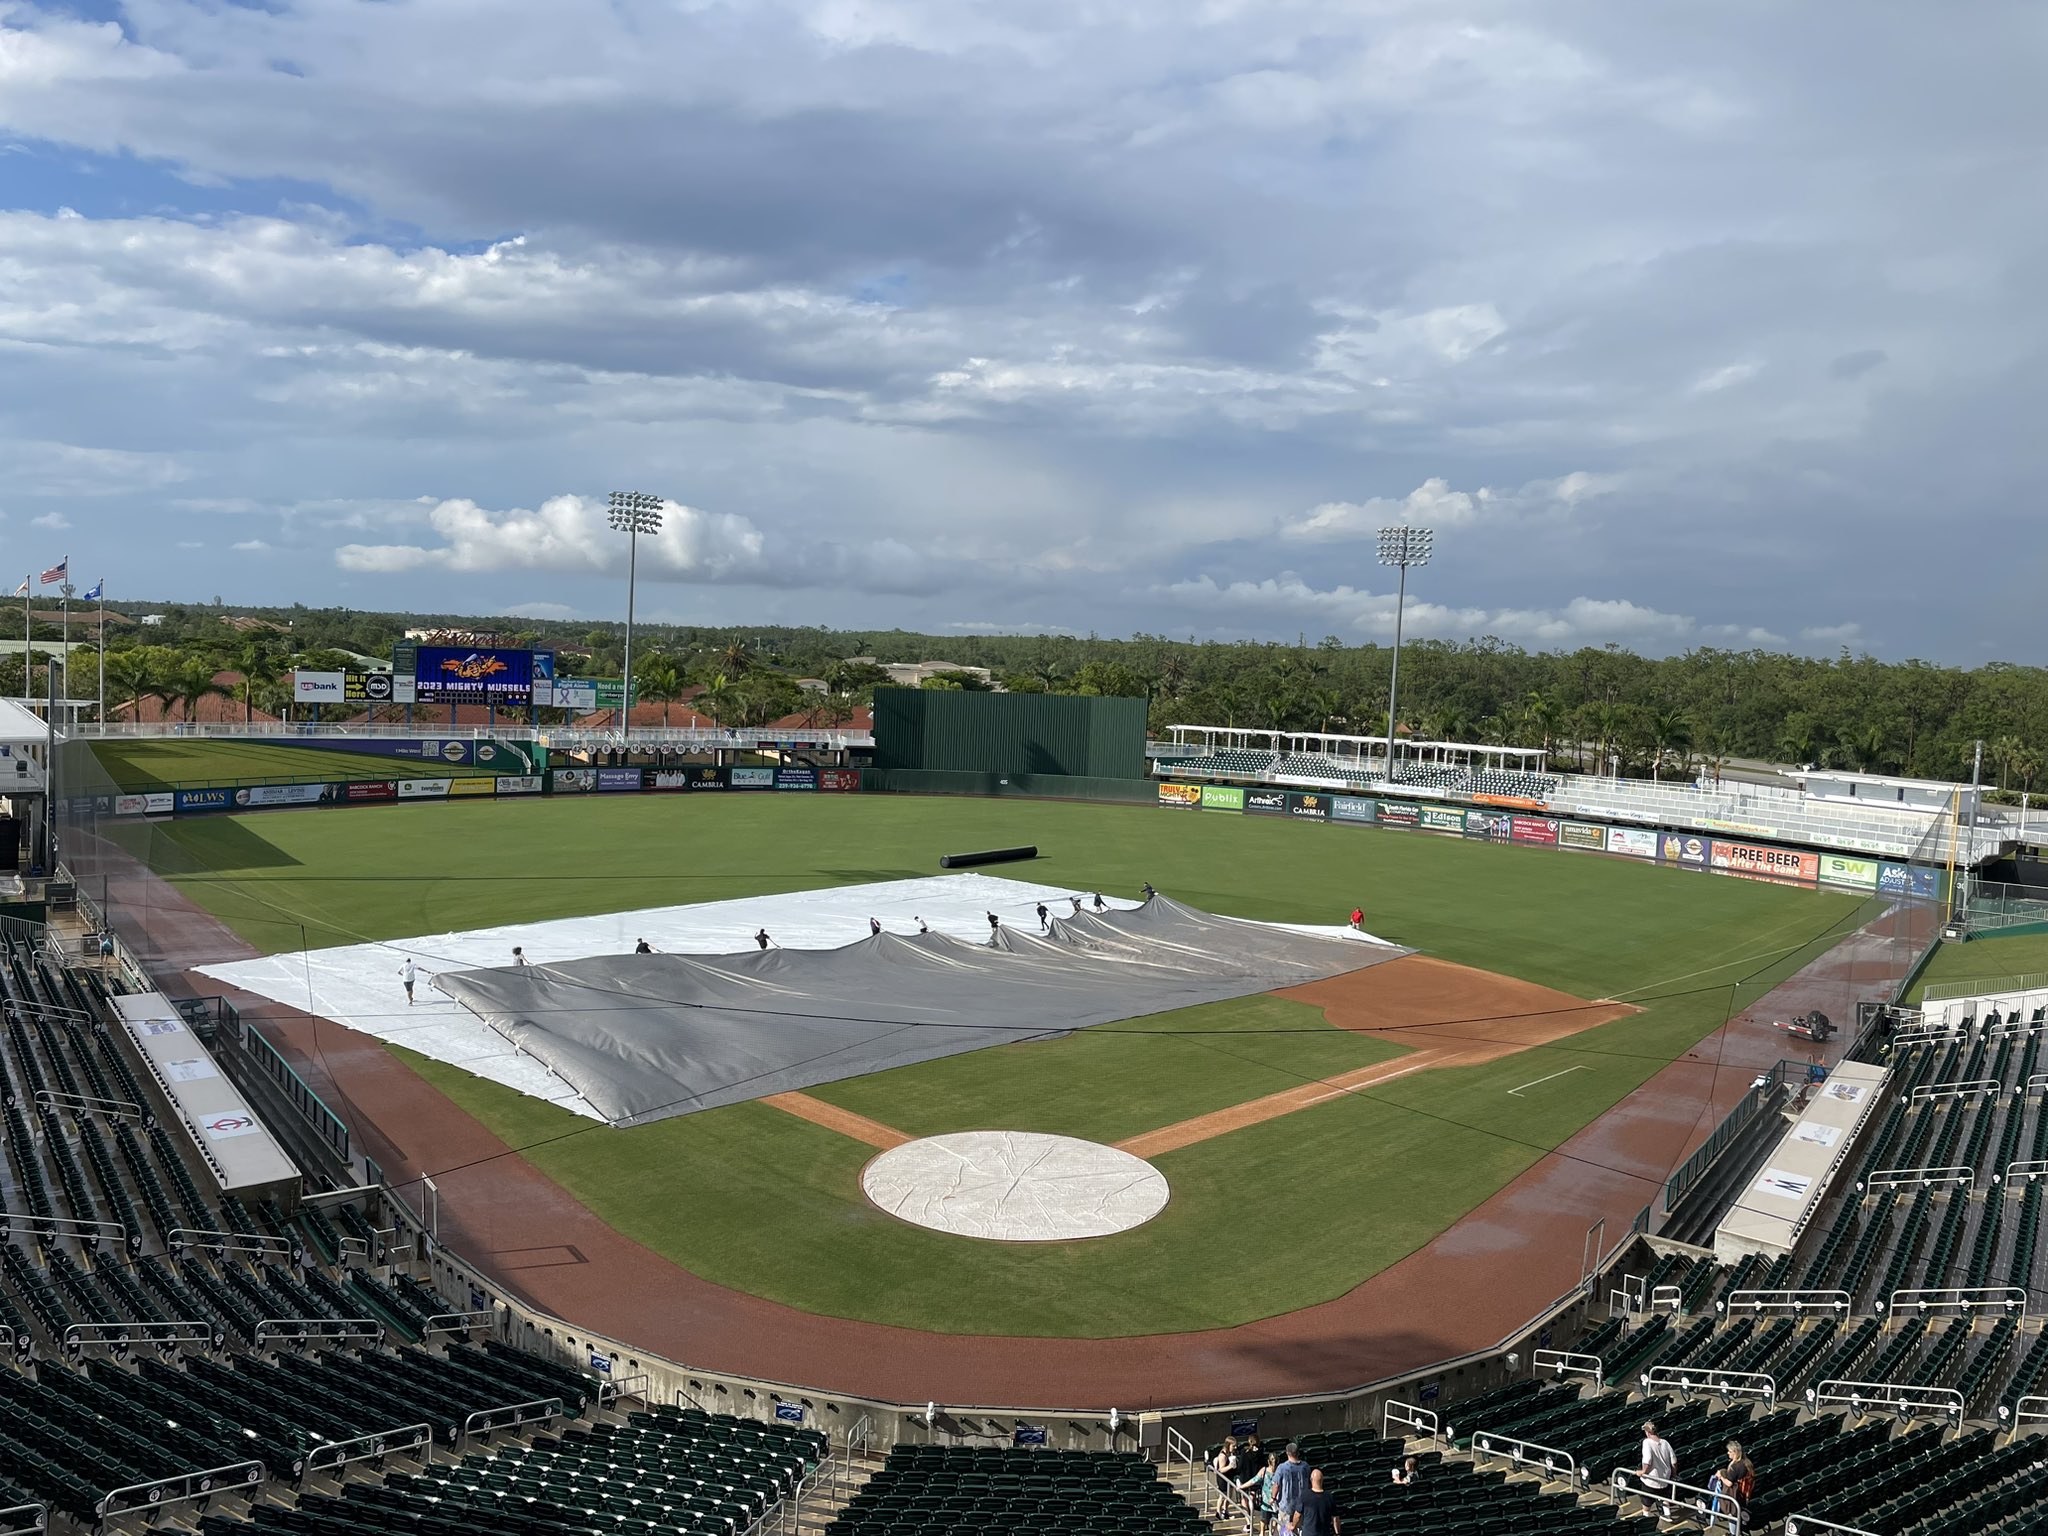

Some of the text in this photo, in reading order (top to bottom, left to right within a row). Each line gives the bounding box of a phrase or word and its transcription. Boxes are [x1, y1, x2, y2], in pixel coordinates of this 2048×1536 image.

[417, 681, 442, 690] 2023
[446, 682, 483, 691] MIGHTY
[487, 683, 531, 693] MUSSELS
[597, 682, 611, 690] Need
[345, 690, 366, 698] Here
[600, 773, 624, 781] Massage
[625, 772, 639, 781] Envy
[733, 771, 747, 780] Blue
[692, 781, 724, 789] CAMBRIA
[1160, 785, 1180, 794] TRULY
[1205, 792, 1238, 803] Publix
[1334, 800, 1365, 813] Fairfield
[1293, 807, 1325, 817] CAMBRIA
[1432, 812, 1461, 823] Edison
[1565, 826, 1592, 835] amavida
[1732, 847, 1800, 868] FREE BEER
[1730, 858, 1801, 876] After the Game
[1831, 859, 1867, 874] SW
[1882, 866, 1907, 879] Ask
